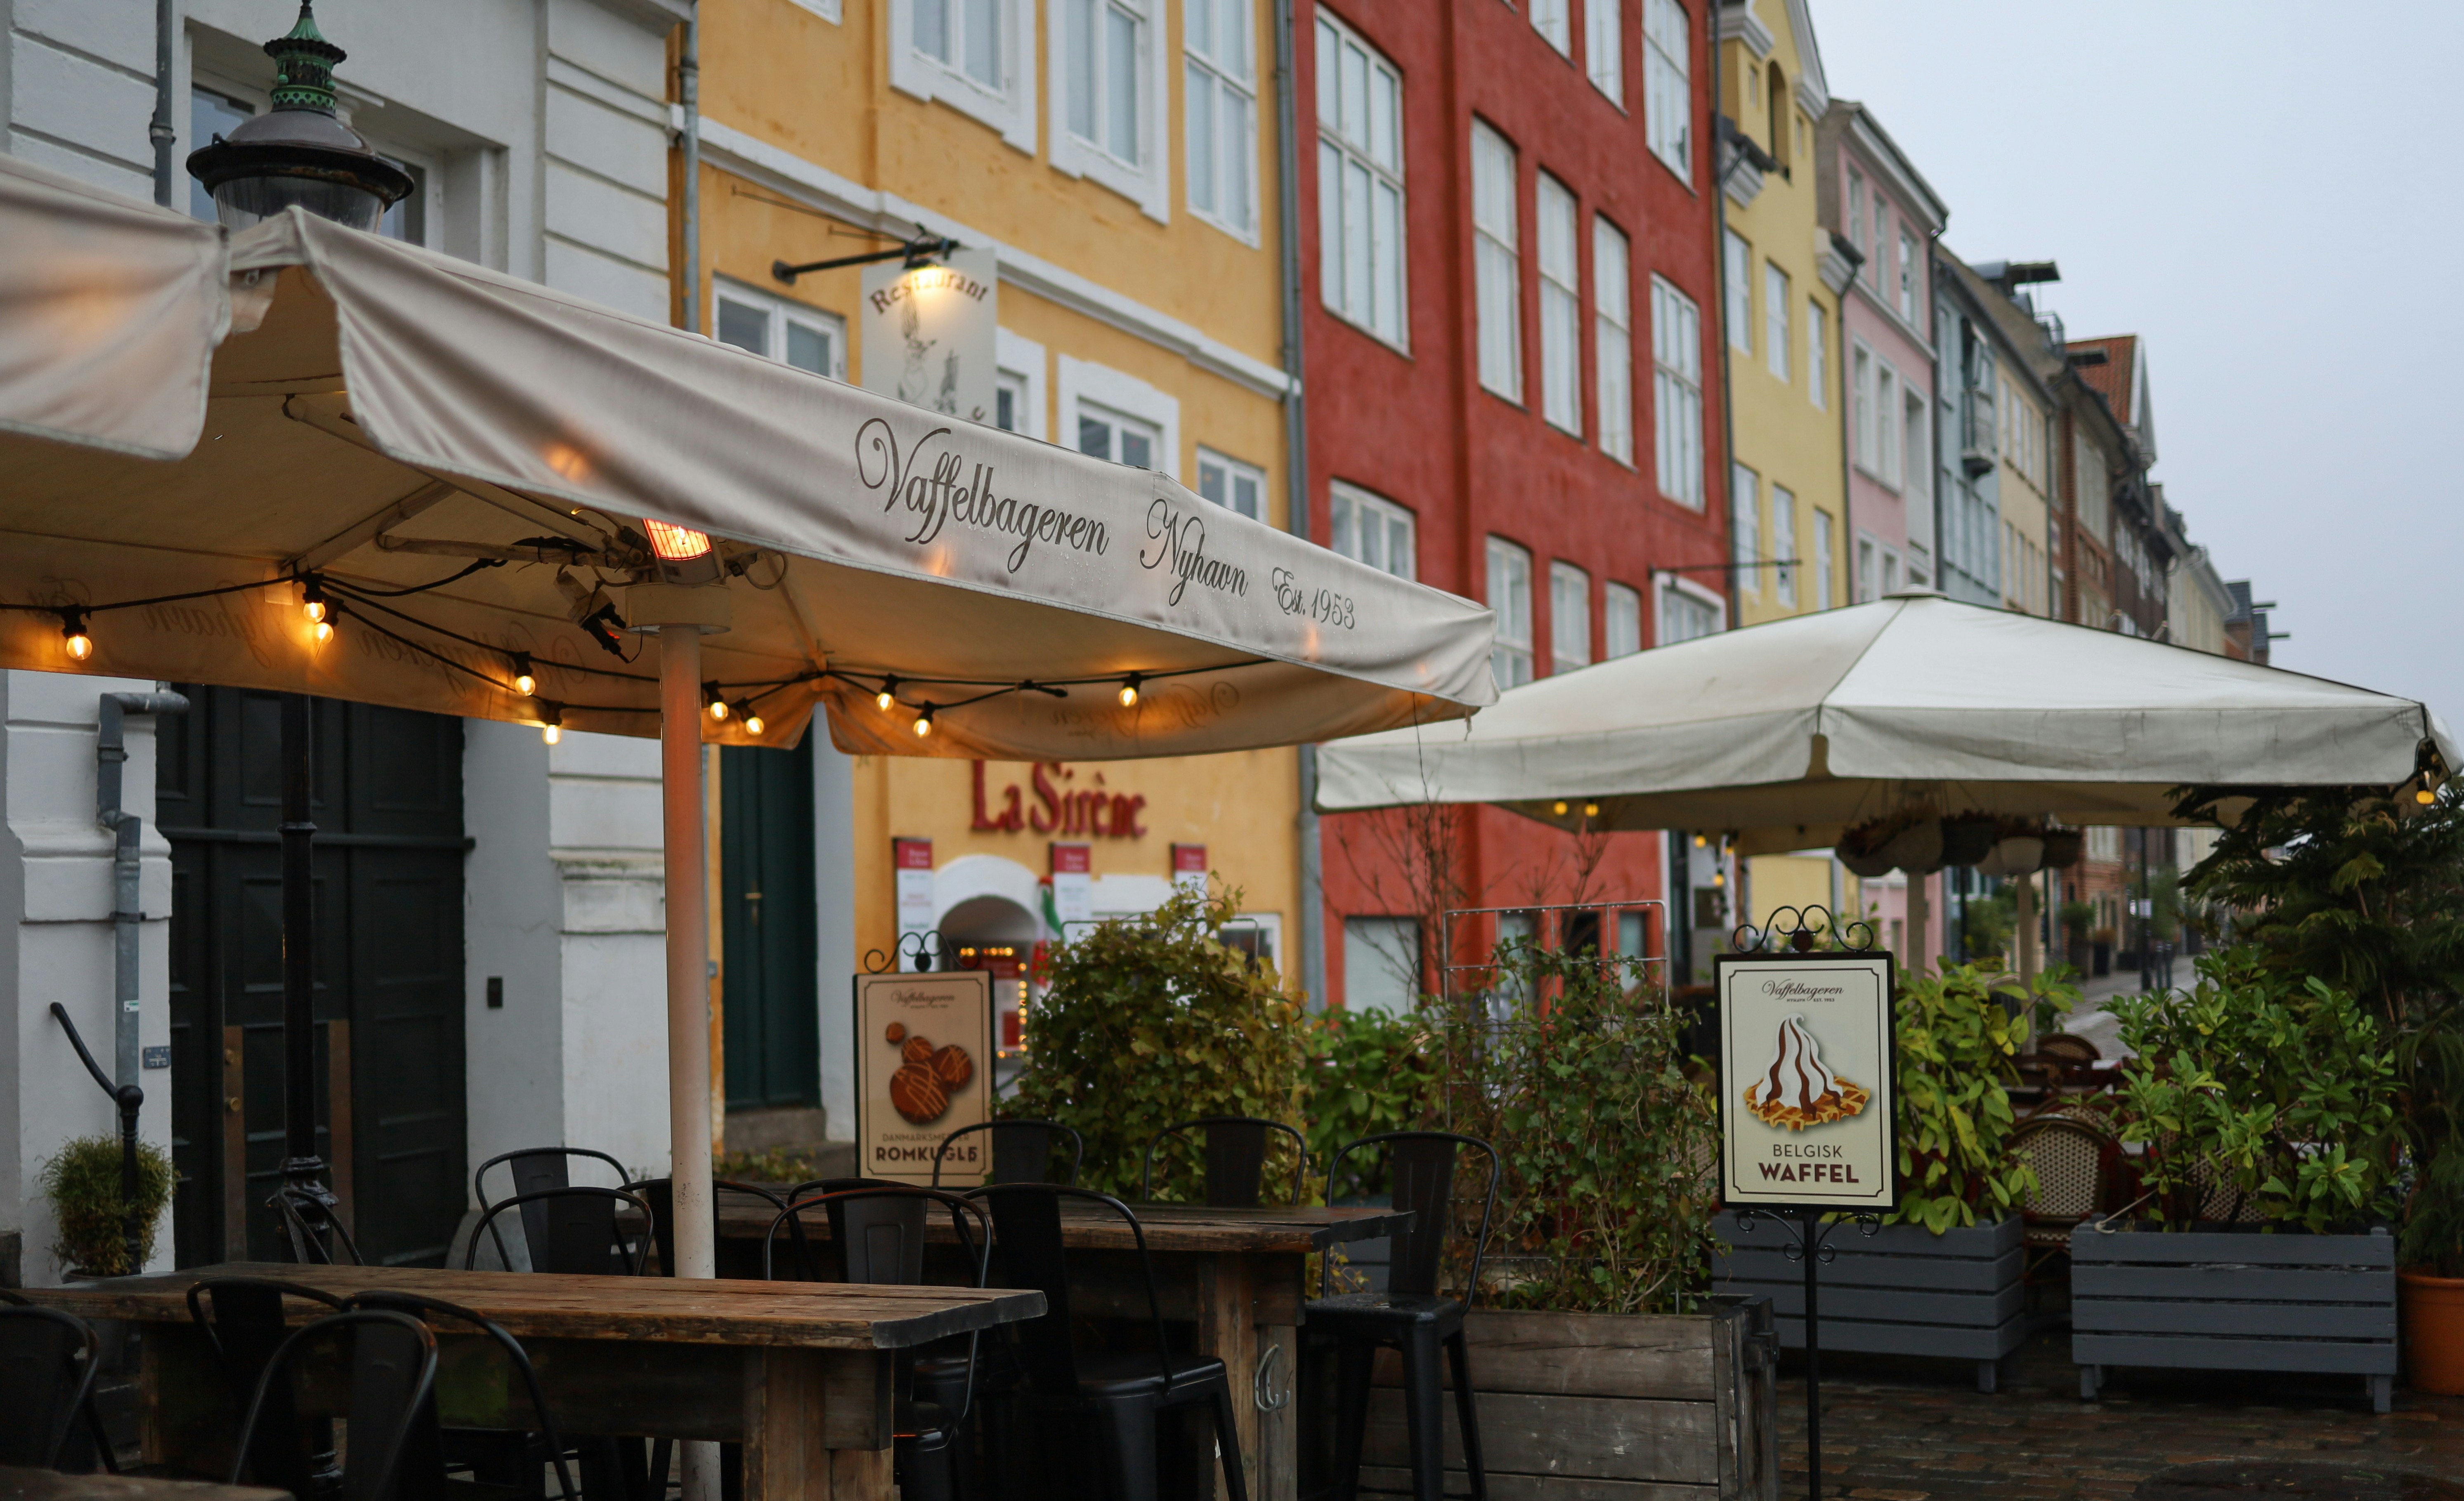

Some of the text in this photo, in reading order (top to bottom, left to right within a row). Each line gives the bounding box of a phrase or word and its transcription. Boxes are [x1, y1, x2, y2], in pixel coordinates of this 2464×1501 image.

[855, 418, 1355, 630] Vaffelbageren Nyhavn Est. 1953
[972, 759, 1147, 838] La Sirène
[1762, 978, 1844, 1001] Vaffelbageren
[1773, 1144, 1843, 1158] BELGISK
[1758, 1162, 1859, 1183] WAFFEL
